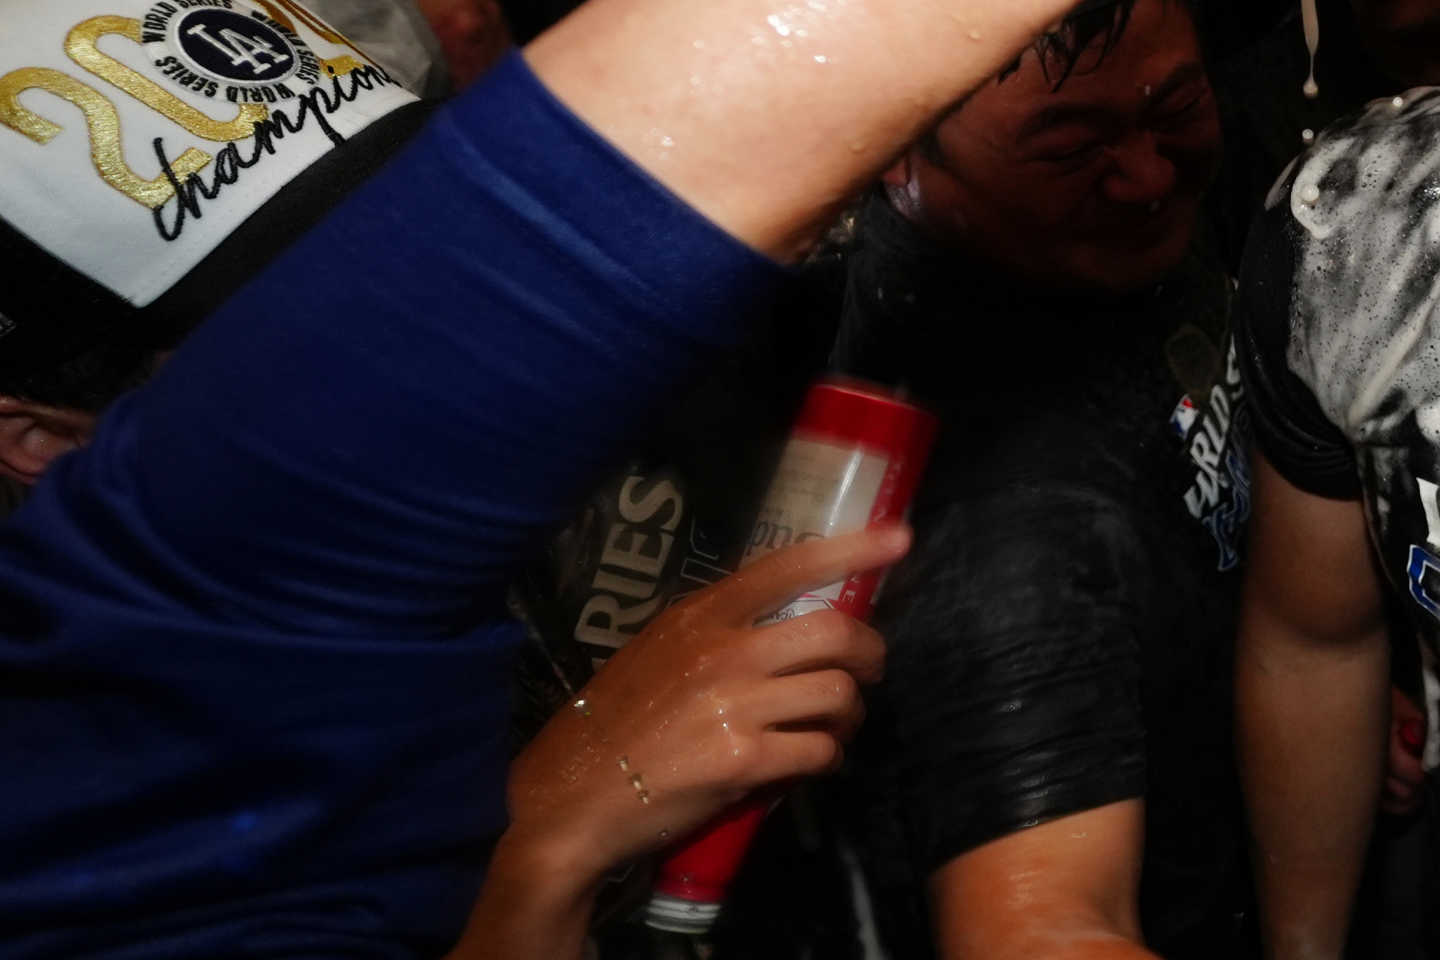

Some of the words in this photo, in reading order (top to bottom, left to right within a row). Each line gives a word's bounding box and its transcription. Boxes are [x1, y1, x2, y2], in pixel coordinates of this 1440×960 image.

[142, 1, 179, 44] WORLD
[186, 23, 290, 75] LA
[155, 55, 219, 98] SERIES
[226, 82, 296, 104] WORLD
